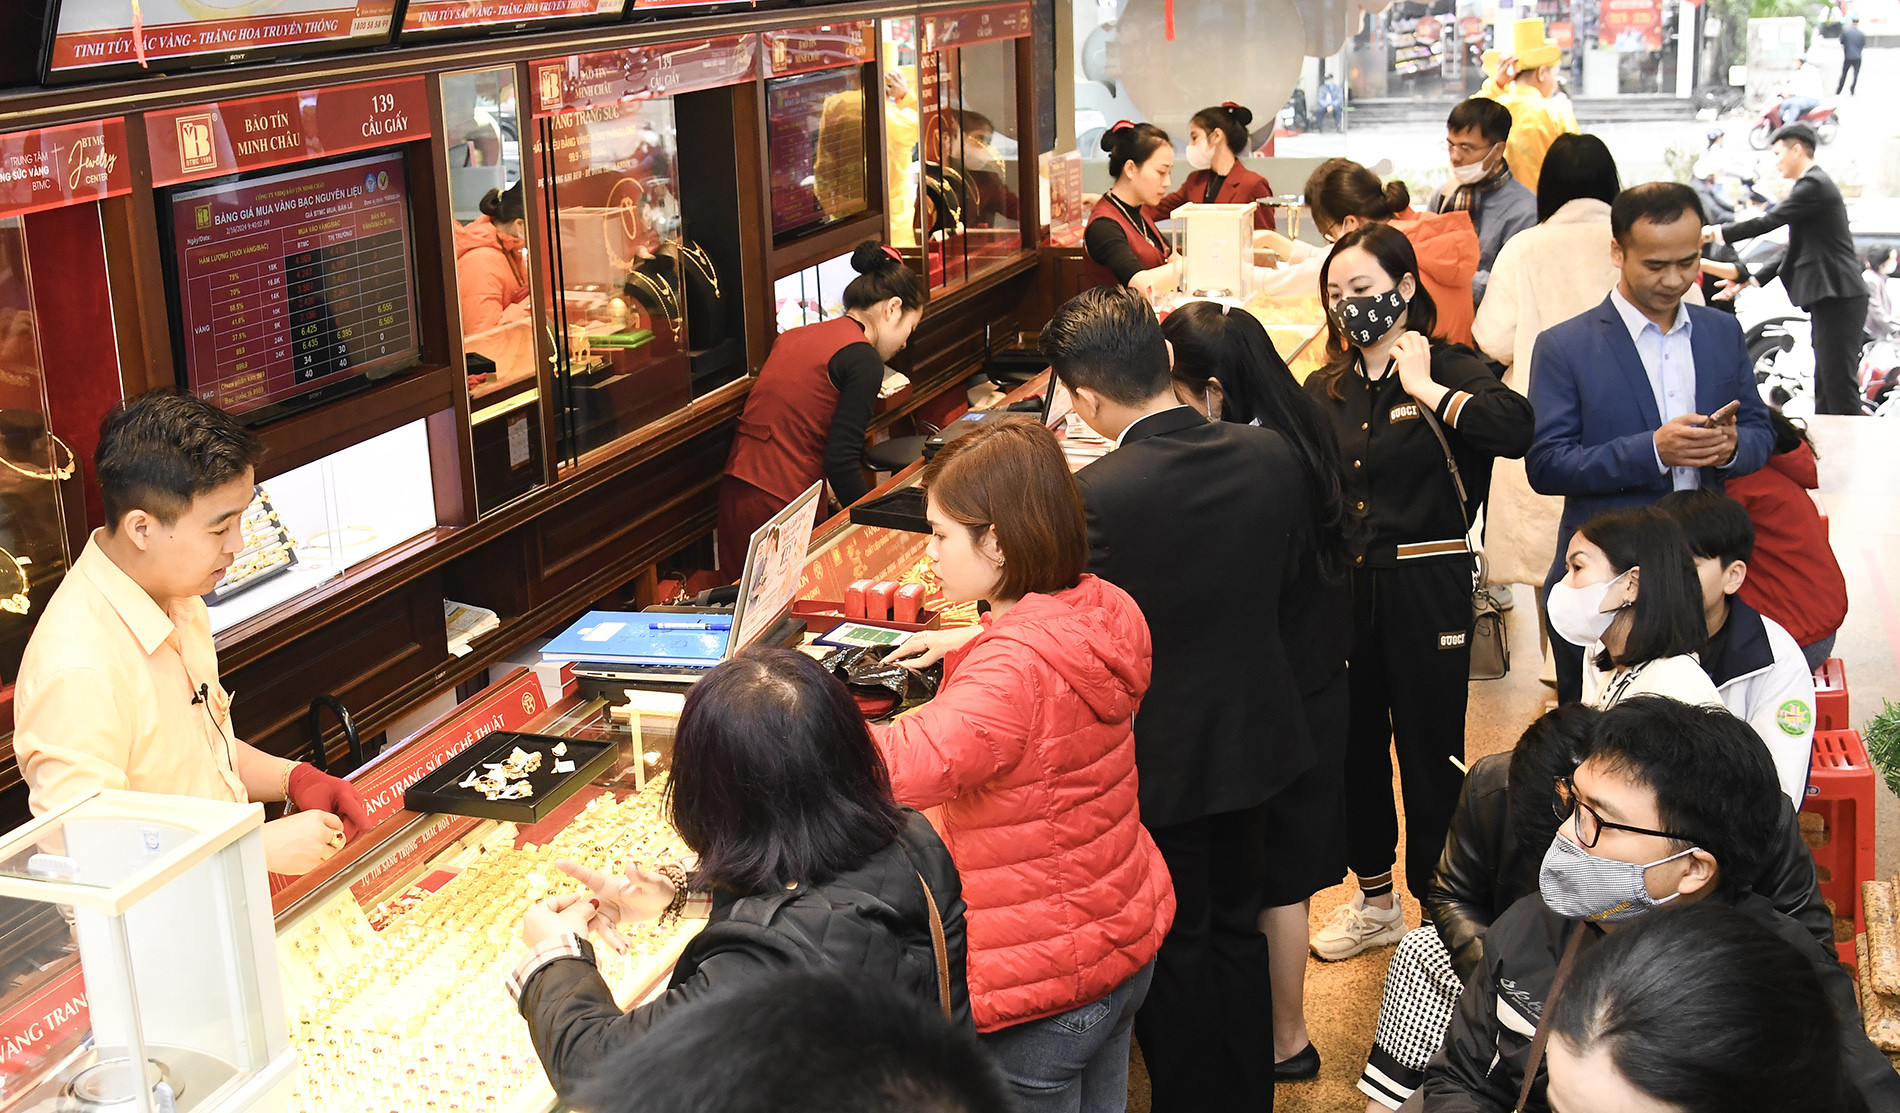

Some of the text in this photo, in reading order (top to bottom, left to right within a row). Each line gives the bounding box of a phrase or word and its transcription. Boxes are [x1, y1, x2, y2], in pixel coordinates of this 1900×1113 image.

[418, 10, 438, 22] TINH
[439, 8, 455, 20] TÚY
[472, 4, 493, 17] VÀNG
[498, 3, 523, 15] THĂNG
[523, 3, 538, 13] HOA
[74, 45, 105, 58] TINH
[107, 37, 131, 53] TÚY
[159, 32, 191, 49] VÀNG
[199, 28, 236, 44] THĂNG
[238, 26, 261, 40] HOA
[262, 21, 302, 37] TRUYỀN
[304, 17, 339, 33] THỐNG
[372, 93, 395, 114] 139
[244, 110, 289, 133] BẢO TÍN
[361, 110, 409, 138] CẦU GIẤY
[81, 135, 105, 148] BTMC
[237, 133, 300, 157] MINH CHÂU
[10, 150, 49, 167] TRUNG TÂM
[68, 140, 117, 190] Jewelry
[13, 167, 28, 180] SỨC
[29, 165, 50, 177] VÀNG
[85, 172, 109, 184] CENTER
[32, 179, 51, 191] BTMC
[215, 185, 363, 226] BẢNG GIÁ MUA VÀNG BẠC NGUYÊN LIỆU
[195, 324, 211, 334] VÀNG
[301, 324, 317, 336] 6.425
[302, 337, 319, 350] 6.435
[380, 333, 384, 341] 0
[338, 345, 346, 354] 30
[381, 346, 385, 354] 0
[304, 355, 312, 364] 34
[339, 358, 348, 367] 40
[305, 369, 313, 378] 40
[362, 790, 391, 816] ÀNG
[389, 767, 426, 798] TRANG
[474, 714, 506, 741] THUẬT
[383, 857, 399, 871] SANG
[43, 992, 88, 1031] TRAN
